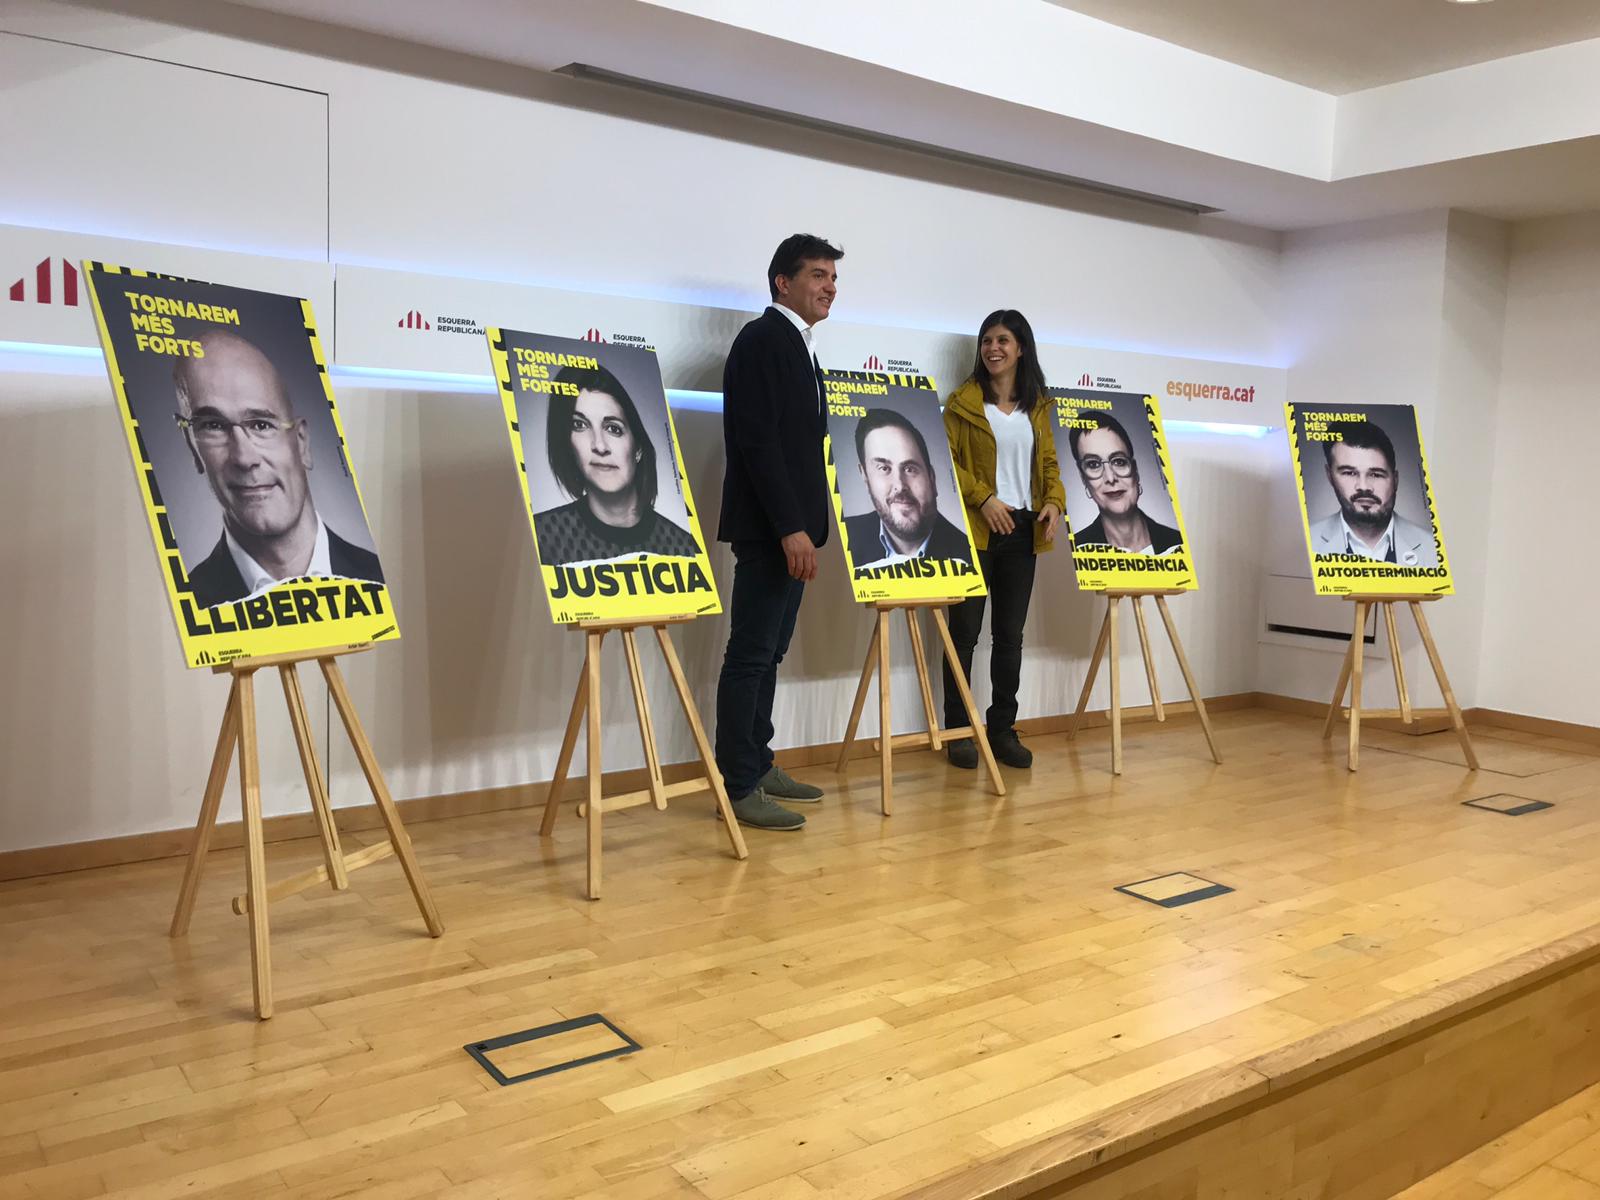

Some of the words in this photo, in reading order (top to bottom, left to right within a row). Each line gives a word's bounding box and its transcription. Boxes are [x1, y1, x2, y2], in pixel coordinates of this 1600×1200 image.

[124, 290, 240, 326] TORNAREM
[131, 310, 175, 336] MÉS
[437, 316, 476, 327] ESQUERRA
[613, 333, 646, 343] ESQUERRA
[135, 333, 205, 359] FORTS
[513, 347, 599, 371] TORNAREM
[887, 359, 912, 367] ESQUERRA
[517, 361, 549, 379] MÉS
[887, 366, 920, 374] REPUBLICANA
[521, 377, 580, 397] FORTES
[823, 380, 888, 396] TORNAREM
[1166, 378, 1255, 403] esquerra.cat
[826, 392, 851, 405] MÉS
[1055, 397, 1113, 411] TORNAREM
[828, 404, 867, 418] FORTS
[1057, 406, 1079, 418] MÉS
[1302, 412, 1367, 423] TORNAREM
[1058, 417, 1099, 430] FORTES
[1304, 420, 1328, 432] MÉS
[1306, 432, 1344, 442] FORTS
[1073, 555, 1189, 572] INDEPENDÈNCIA
[550, 554, 713, 599] JUSTÍCIA
[1317, 564, 1448, 578] AUTODETERMINACIÓ
[180, 584, 385, 637] LLIBERTAT
